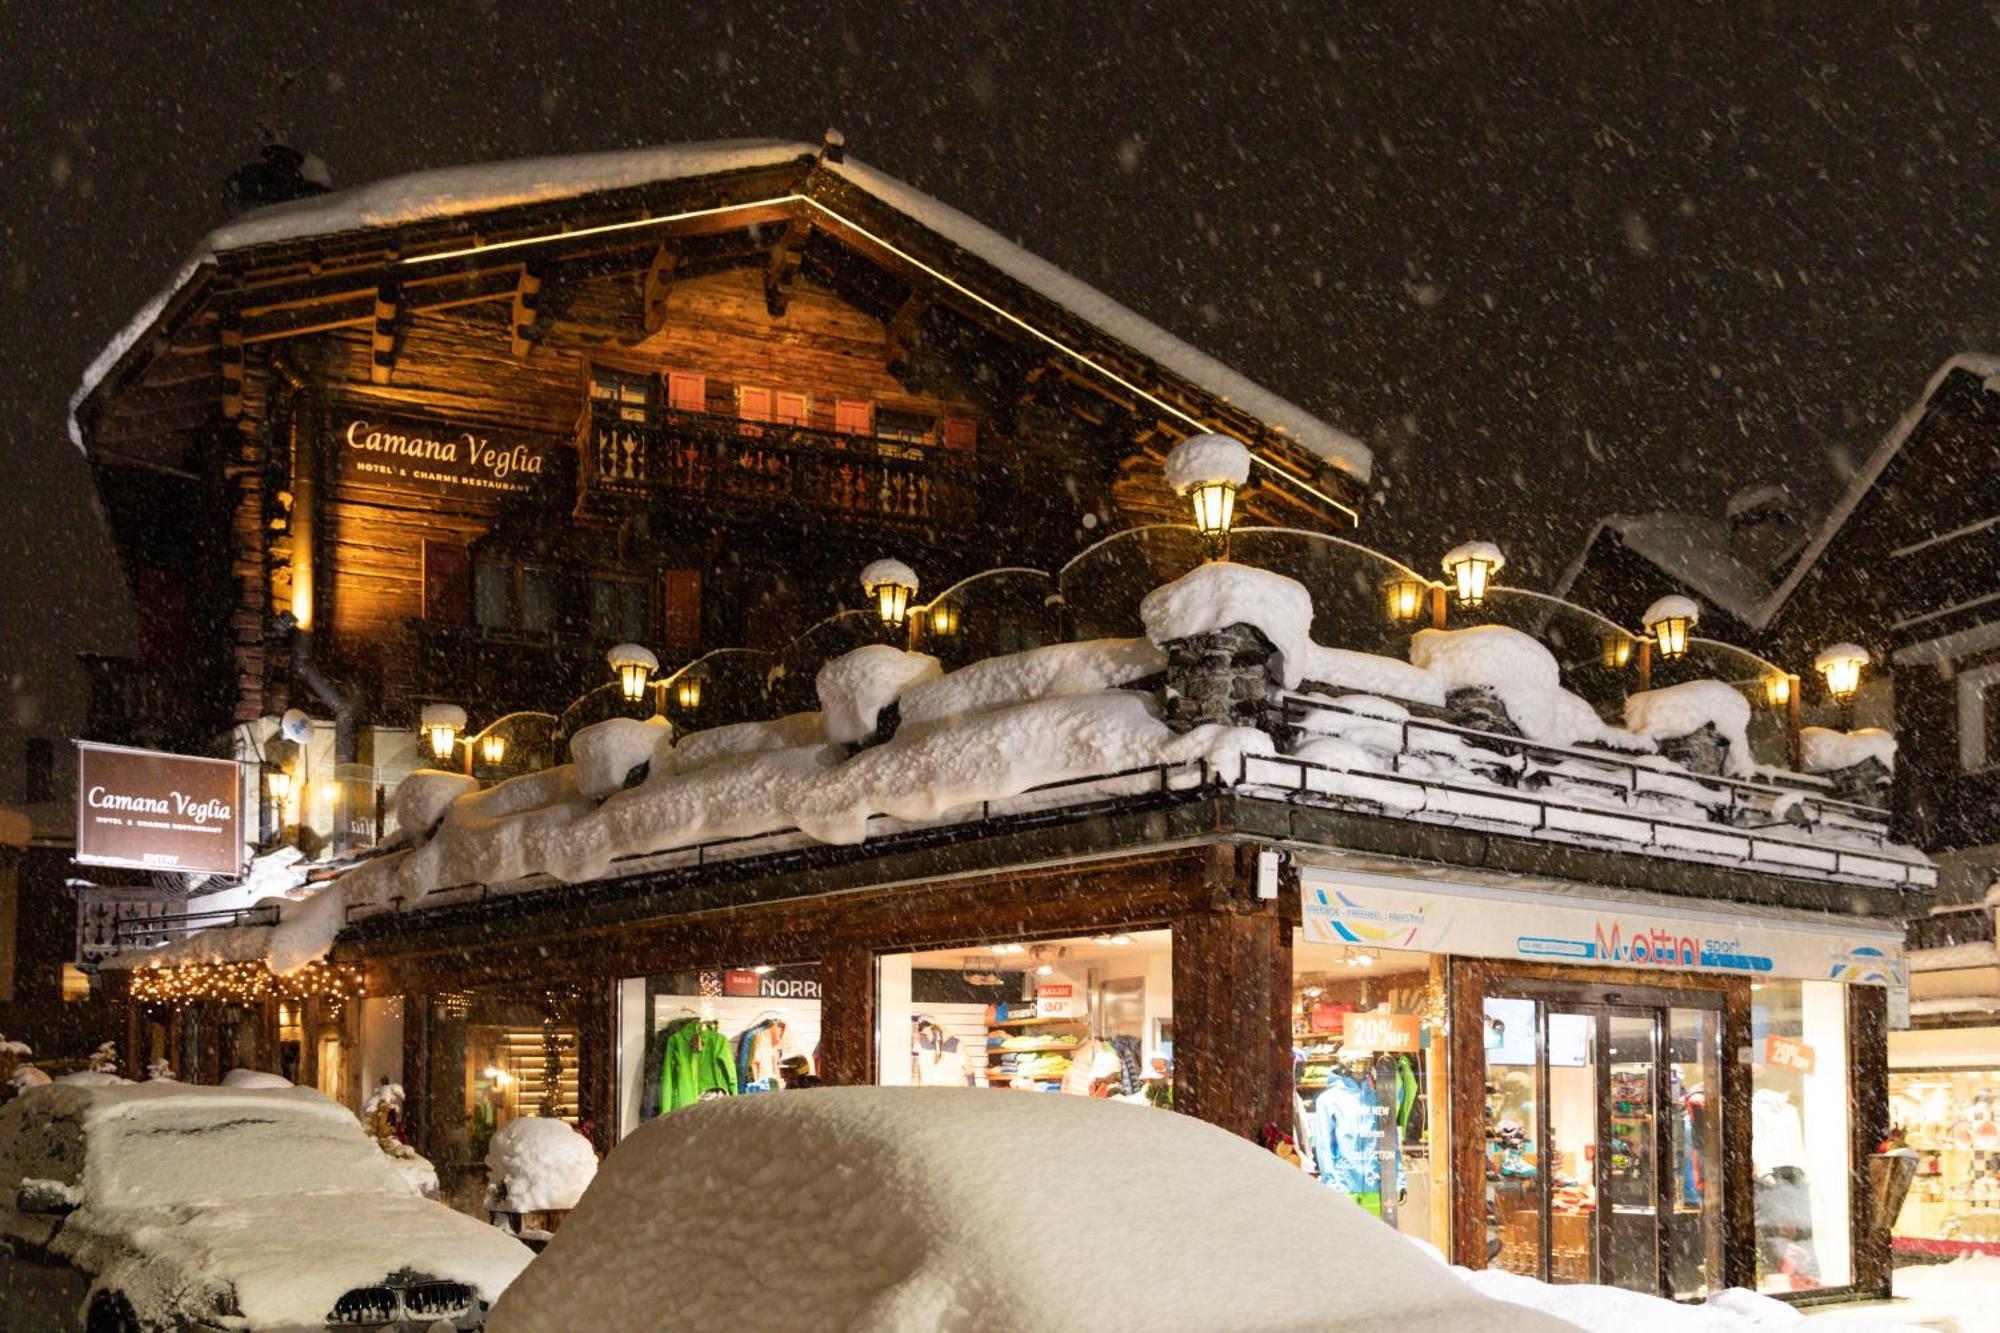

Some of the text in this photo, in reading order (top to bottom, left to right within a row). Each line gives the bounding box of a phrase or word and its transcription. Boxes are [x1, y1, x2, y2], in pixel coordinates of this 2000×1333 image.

[347, 420, 543, 478] Camana Veglia
[357, 462, 531, 493] HOTEL & CHARME RESTAURANT
[88, 786, 231, 823] Camana Veglia
[1595, 919, 1700, 968] Mottini
[1705, 938, 1740, 953] sport
[761, 979, 822, 998] NORR
